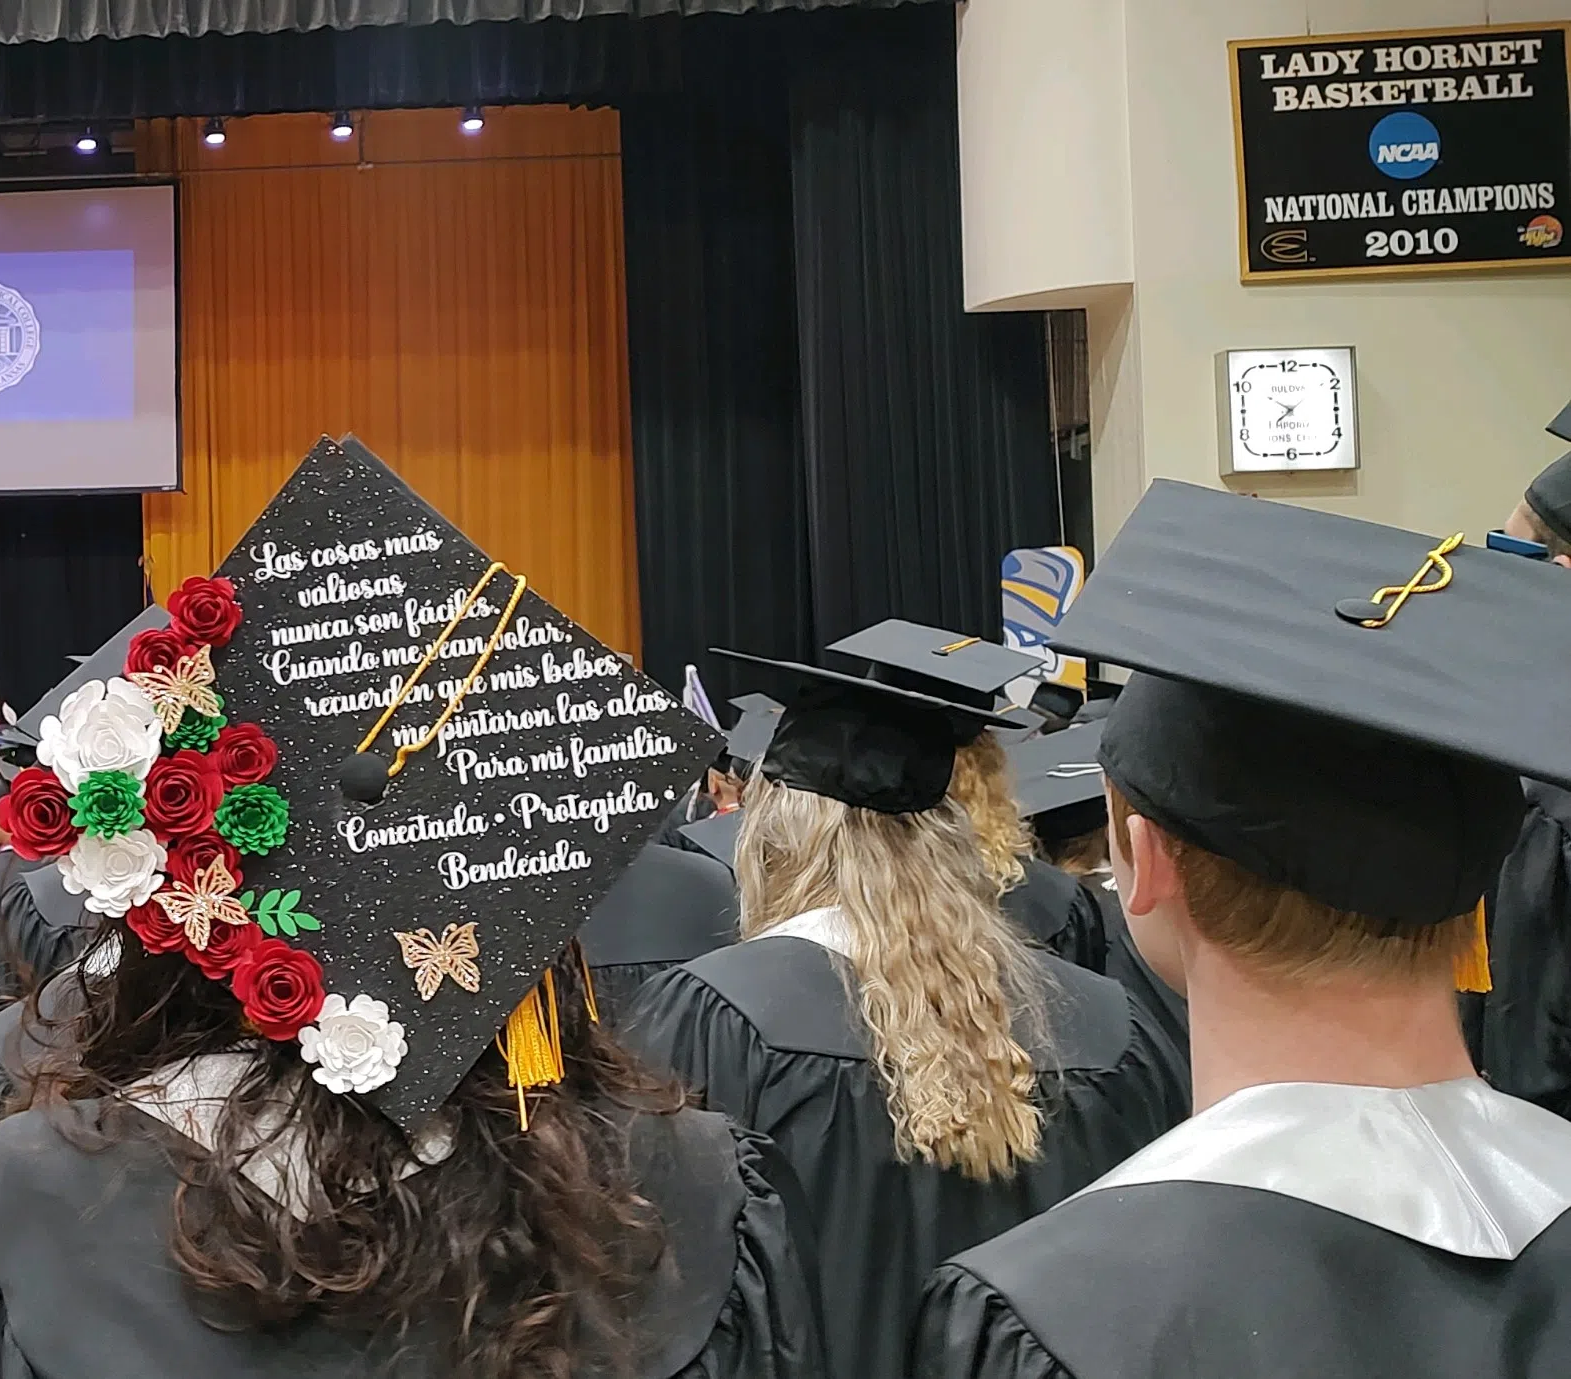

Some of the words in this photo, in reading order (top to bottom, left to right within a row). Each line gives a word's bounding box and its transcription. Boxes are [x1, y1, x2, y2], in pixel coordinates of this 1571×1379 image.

[1260, 49, 1364, 80] LADY
[1373, 39, 1542, 72] HORNET
[1272, 73, 1533, 112] BASKETBALL
[1377, 142, 1439, 164] NCAA
[1264, 191, 1395, 224] NATIONAL
[1401, 182, 1555, 217] CHAMPIONS
[1365, 227, 1459, 258] 2010
[1279, 360, 1298, 372] 12
[1330, 378, 1341, 390] 2
[1233, 381, 1252, 393] 10
[1239, 429, 1250, 441] 8
[1331, 427, 1343, 439] 4
[1286, 448, 1298, 460] 6
[250, 541, 308, 581] Las
[311, 540, 381, 568] cosas
[384, 527, 443, 556] más
[297, 572, 407, 608] valiosas
[271, 618, 354, 647] nunca
[354, 610, 403, 636] son
[381, 644, 423, 667] me
[303, 674, 435, 717] recuerden
[437, 675, 488, 713] que
[489, 663, 541, 692] mis
[541, 647, 623, 685] bebes
[392, 724, 432, 747] me
[437, 709, 555, 758] pintaron
[555, 692, 606, 725] las
[446, 748, 529, 785] Para
[530, 744, 569, 773] mi
[569, 726, 678, 779] familia
[336, 803, 489, 853] Conectada
[509, 781, 659, 834] Protegida
[437, 839, 592, 890] Bendecida
